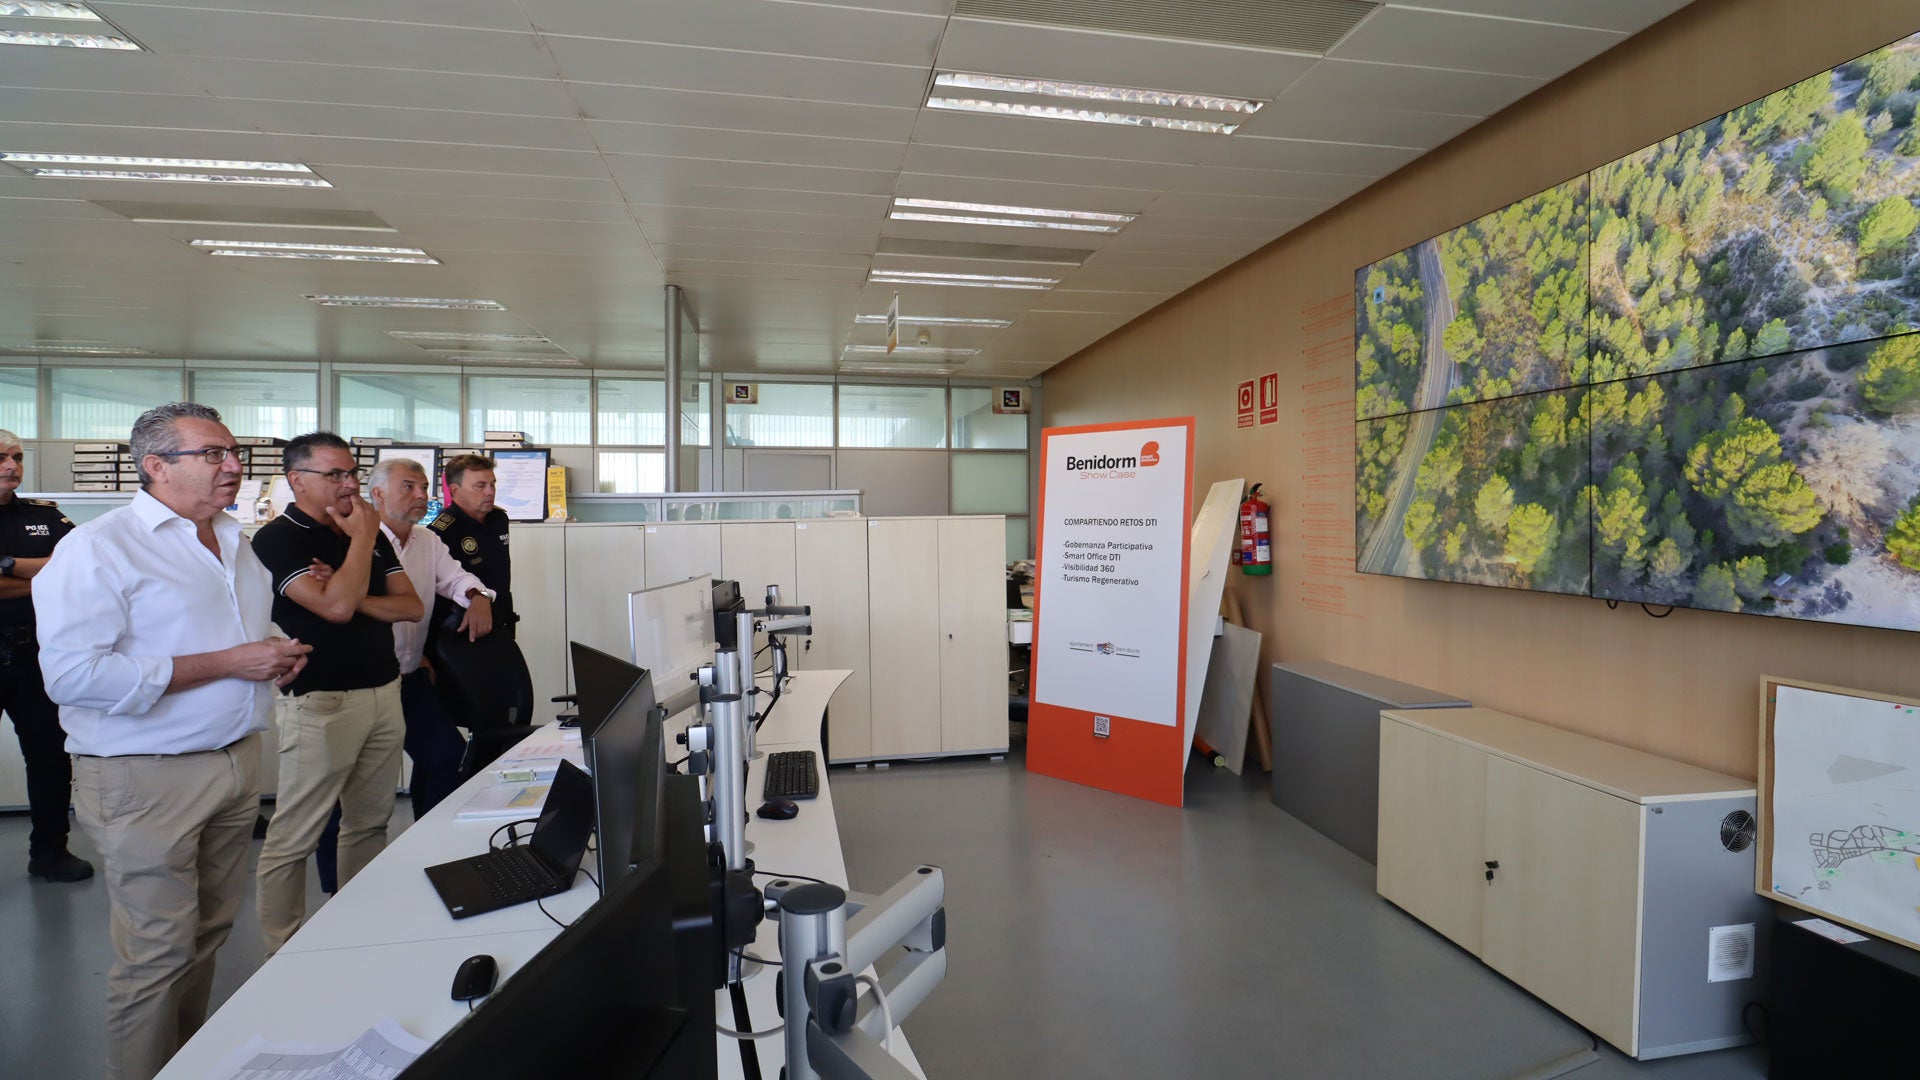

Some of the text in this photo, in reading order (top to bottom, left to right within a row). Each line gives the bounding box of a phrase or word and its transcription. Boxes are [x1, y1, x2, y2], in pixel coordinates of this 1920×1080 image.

[1066, 454, 1137, 471] Benidorm
[1080, 470, 1136, 480] Show Case
[1063, 518, 1158, 527] COMPARTIENDO RETOS DTI
[1063, 540, 1154, 552] -Gobernanza Participativa
[1062, 551, 1121, 561] -Smart Office DTI
[1062, 563, 1115, 573] -Visibilidad 360
[1061, 574, 1139, 586] -Turismo Regenerativo
